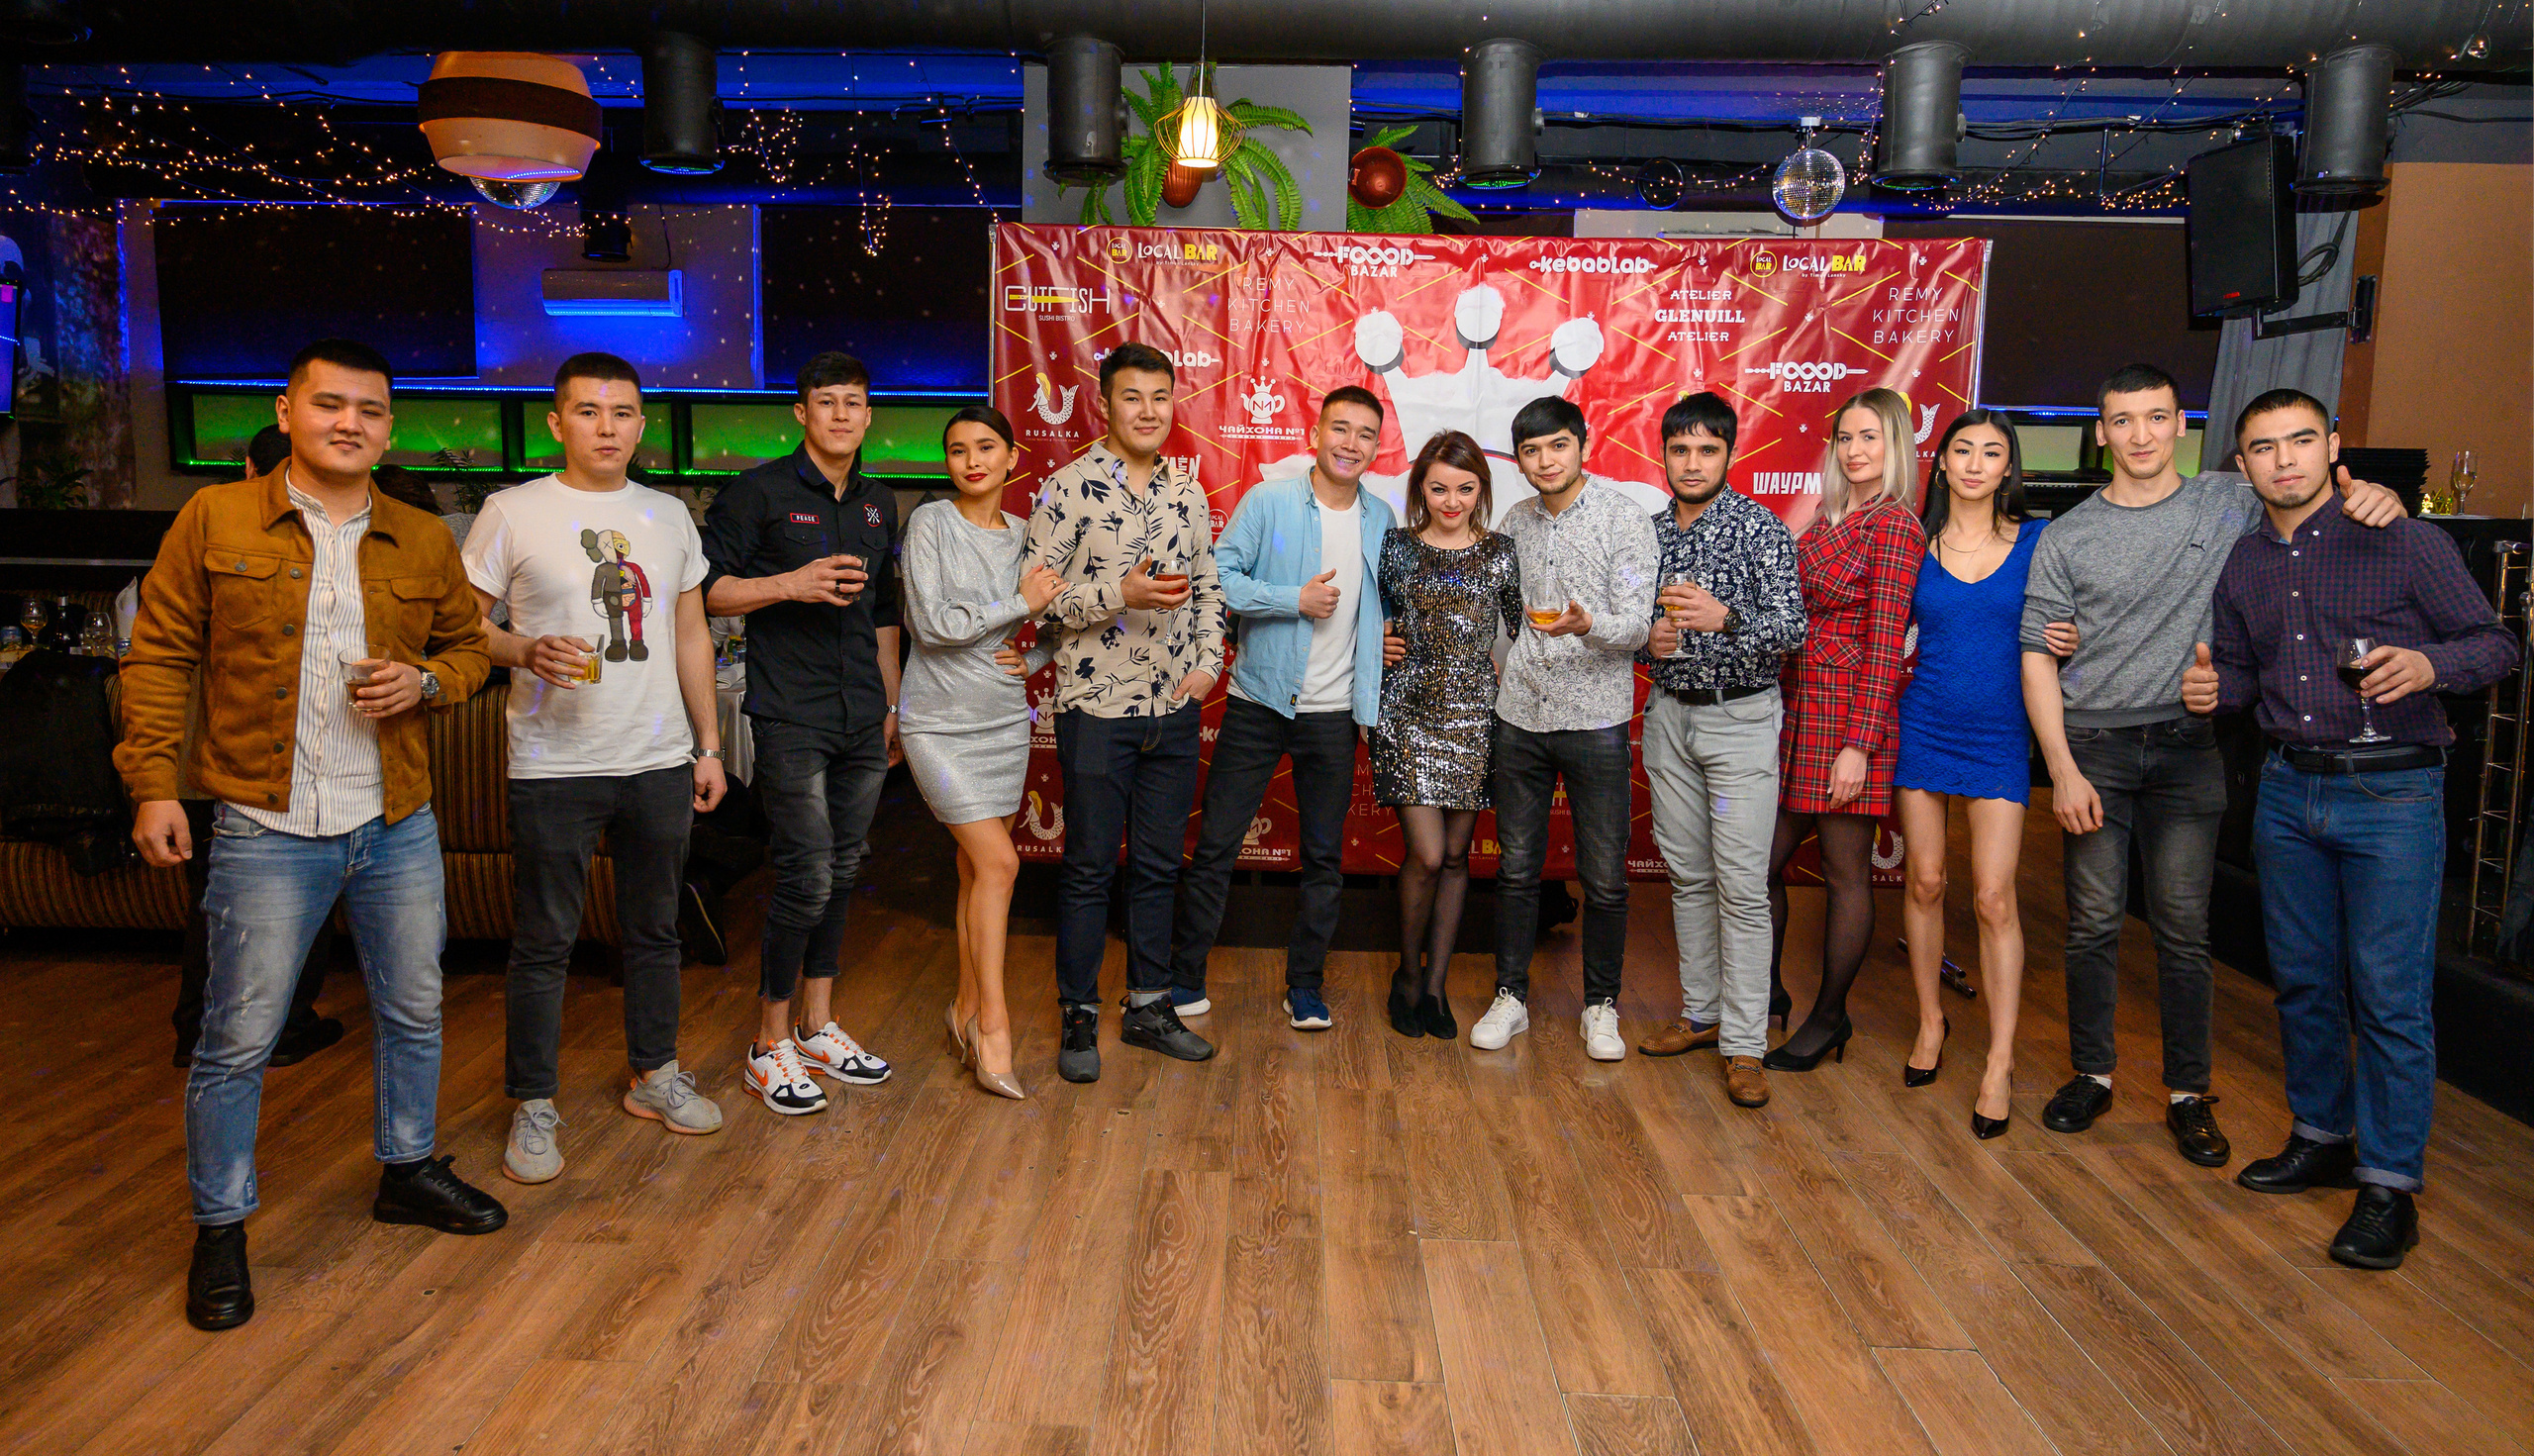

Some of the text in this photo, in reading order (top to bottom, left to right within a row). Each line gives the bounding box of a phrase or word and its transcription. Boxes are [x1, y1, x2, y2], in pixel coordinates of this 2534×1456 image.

[1111, 248, 1127, 257] BAR
[1138, 242, 1218, 261] LOCAL BAR
[1755, 261, 1772, 270] BAR
[1783, 254, 1867, 272] LOCAL BAR
[1350, 265, 1398, 278] BAZAR
[1242, 276, 1295, 291] REMY
[1670, 289, 1732, 301] ATELIER
[1889, 287, 1943, 301] REMY
[1227, 298, 1310, 314] KITCHEN
[1654, 309, 1745, 324] GLENUILL
[1872, 308, 1959, 323] KITCHEN
[1229, 319, 1306, 334] BAKERY
[1667, 332, 1730, 342] ATELIER
[1874, 330, 1955, 344] BAKERY
[1784, 381, 1831, 393] BAZAR
[1025, 430, 1080, 438] RUSALKA
[1218, 424, 1283, 436] ЧАЙХОНА
[1753, 472, 1823, 495] ШАУРМ
[1347, 803, 1392, 816] KERY
[1017, 844, 1062, 853] RUSALK
[1482, 839, 1502, 855] BA
[1627, 858, 1667, 868] ЧАЙХ
